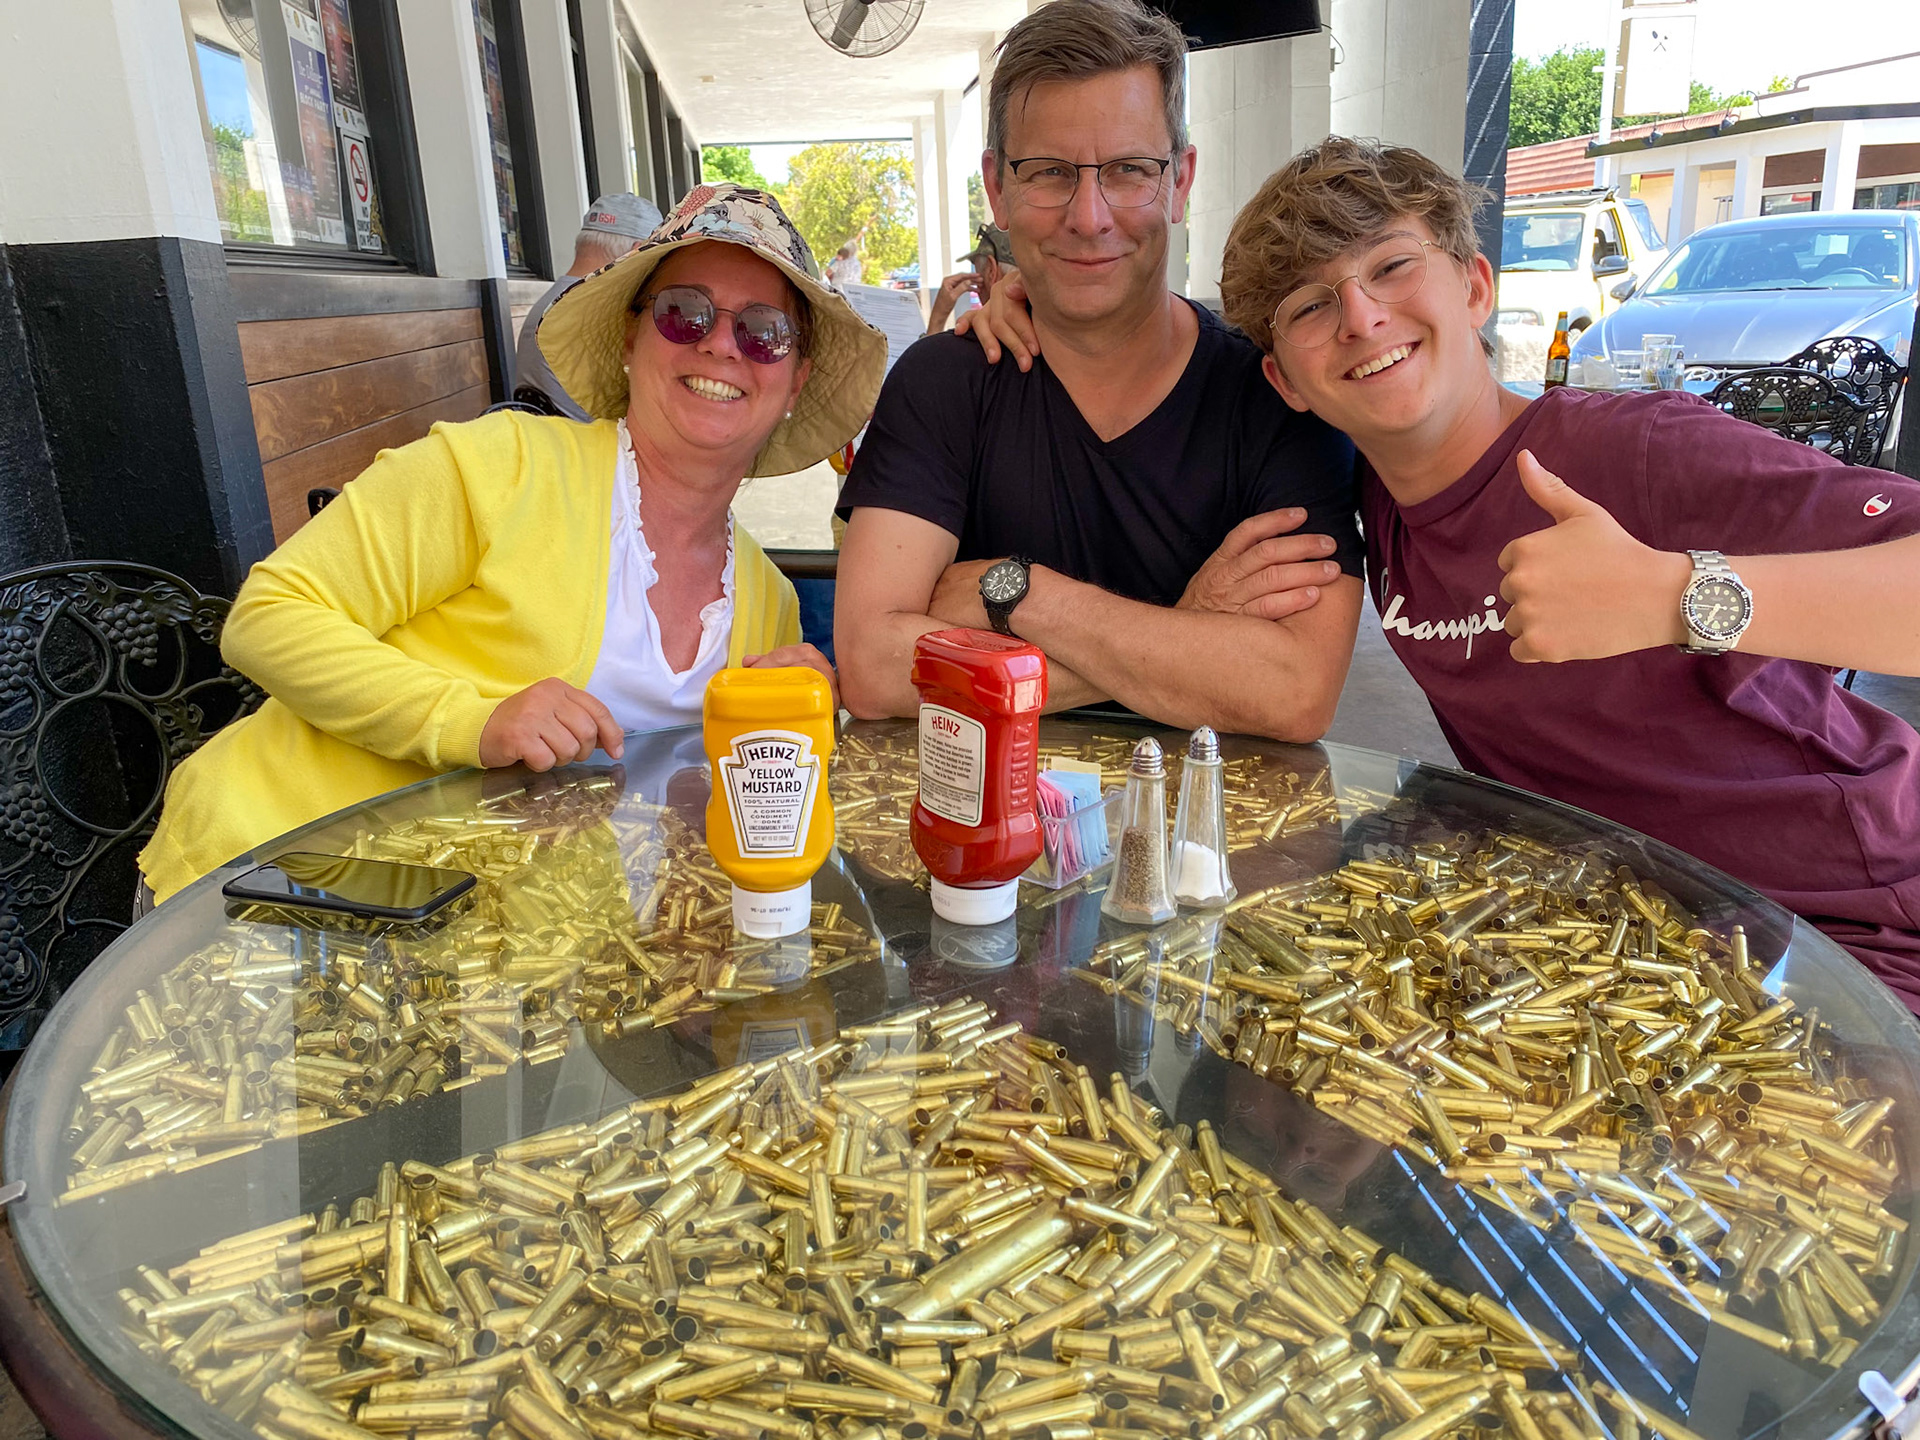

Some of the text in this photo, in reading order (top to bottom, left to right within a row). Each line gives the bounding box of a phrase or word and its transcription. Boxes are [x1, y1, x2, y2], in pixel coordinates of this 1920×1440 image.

[1380, 567, 1507, 660] hampi
[931, 716, 960, 737] HEINZ
[748, 746, 796, 761] HEINZ
[749, 768, 795, 779] YELLOW
[1011, 722, 1034, 809] HEINZ
[742, 781, 802, 794] MUSTARD
